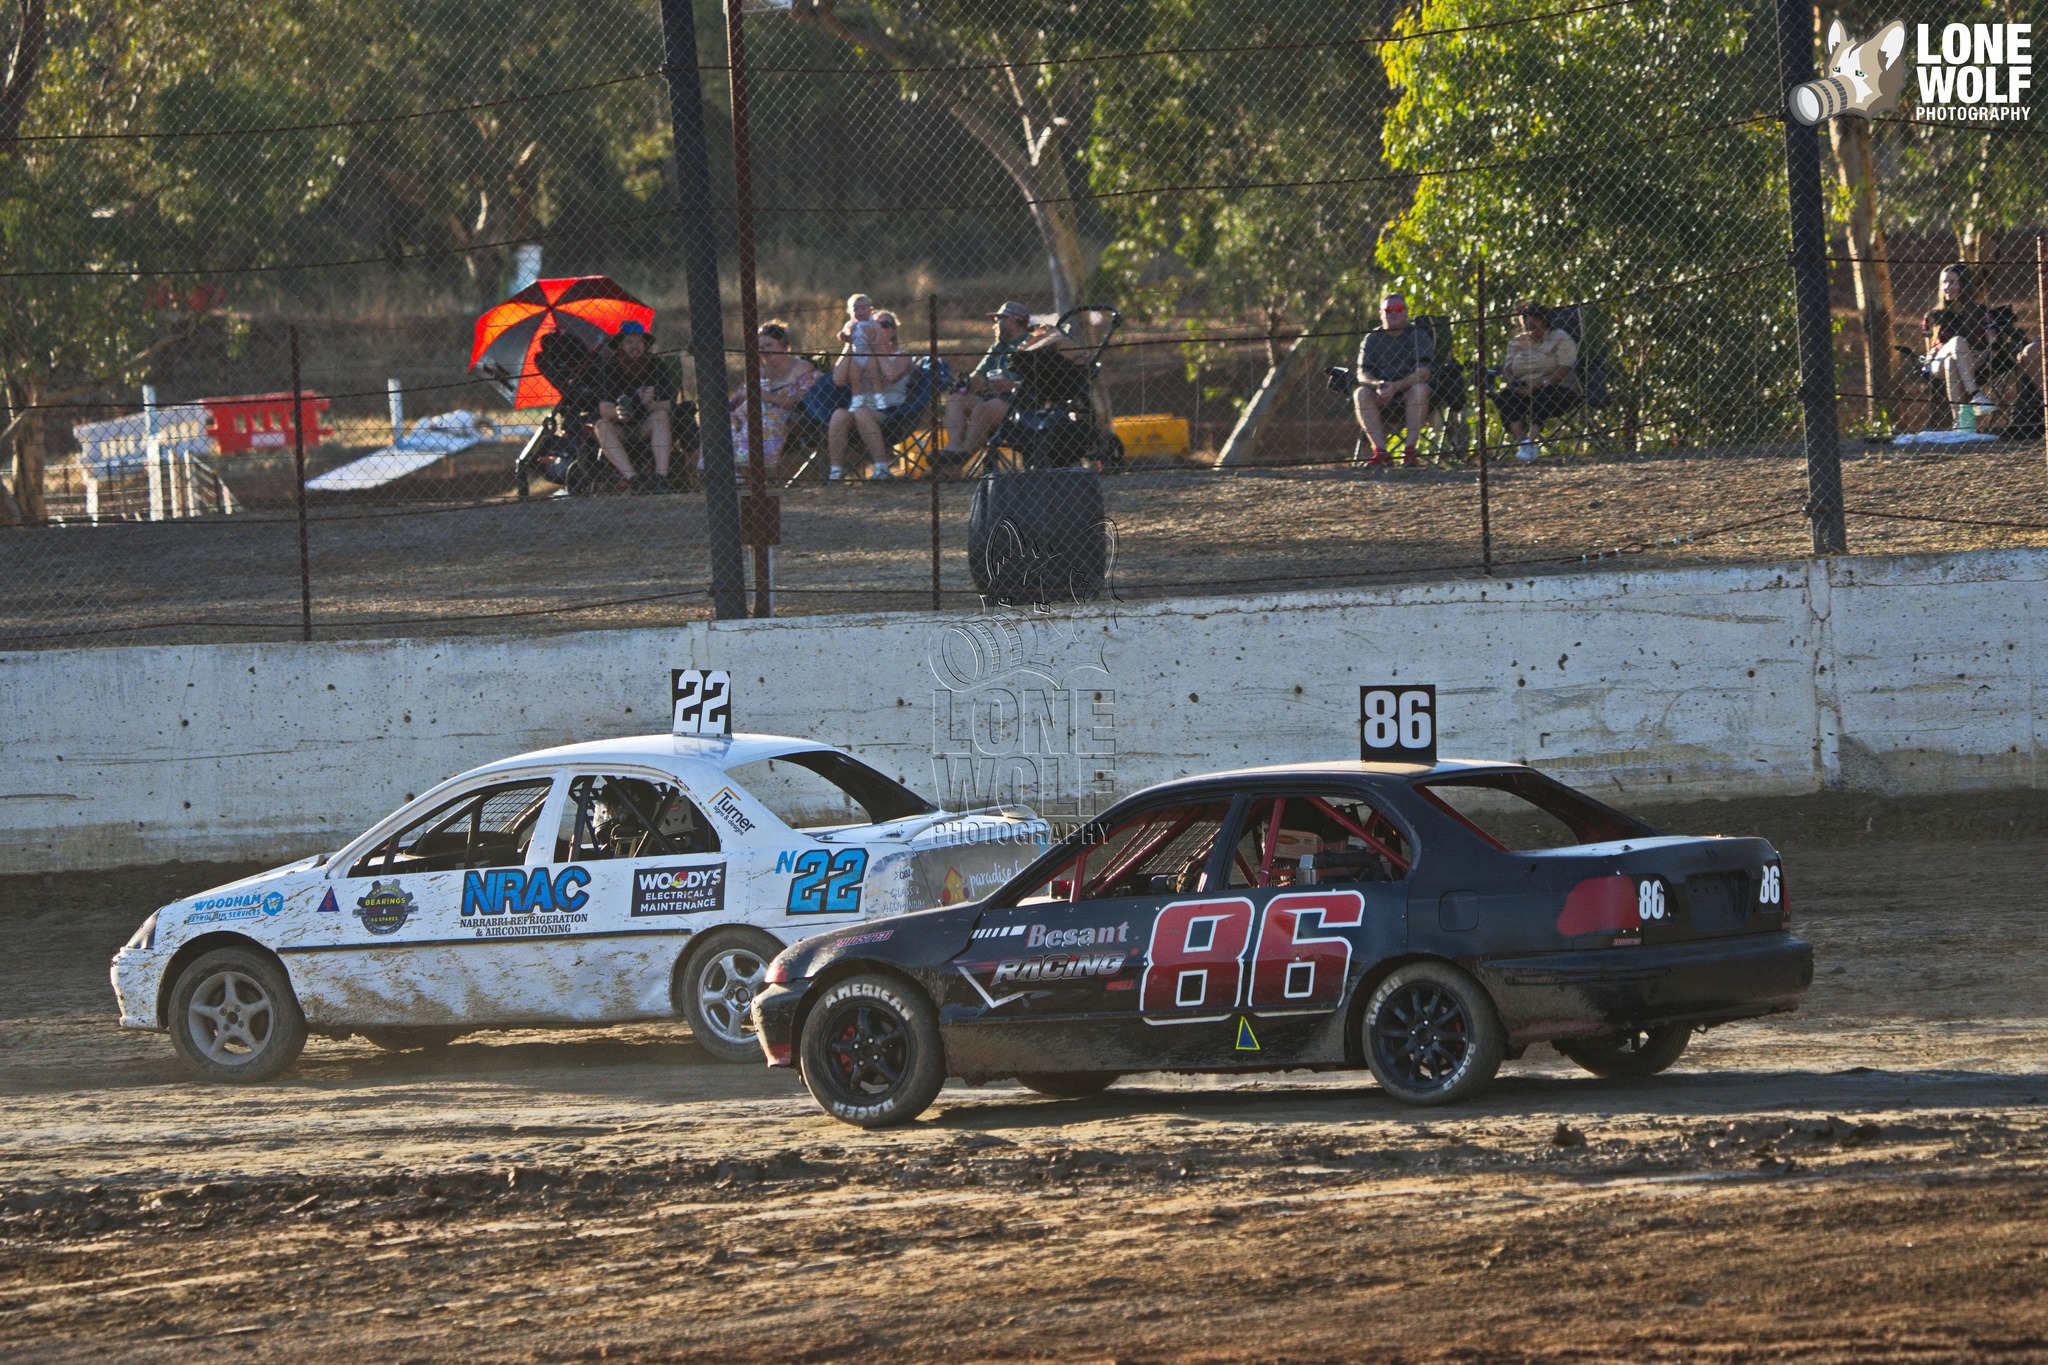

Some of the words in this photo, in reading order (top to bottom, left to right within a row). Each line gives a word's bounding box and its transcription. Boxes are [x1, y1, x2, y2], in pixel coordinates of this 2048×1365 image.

[674, 669, 731, 734] 22
[1363, 690, 1432, 749] 86
[713, 805, 725, 817] signs
[727, 819, 745, 836] designs
[717, 791, 756, 832] Turner
[460, 865, 592, 917] NRAC
[639, 868, 722, 891] WOODY'S
[645, 891, 704, 901] ELECTRICAL
[707, 887, 713, 896] &
[968, 863, 1013, 897] paradise
[1758, 865, 1781, 904] 86
[194, 893, 262, 912] WOODHAM
[229, 909, 261, 918] SERVICES
[365, 897, 406, 906] BEARINGS
[640, 898, 716, 912] MAINTENANCE
[1638, 880, 1665, 920] 86
[460, 918, 508, 928] NARRABRI
[510, 913, 588, 926] REFRIGERATION
[475, 929, 483, 937] &
[485, 924, 571, 937] AIRCONDITIONING
[1026, 921, 1129, 949] Besant
[1139, 890, 1365, 1026] 86
[825, 983, 914, 1022] AMERICAN
[1366, 976, 1403, 1026] RACER
[831, 1098, 896, 1121] RACER
